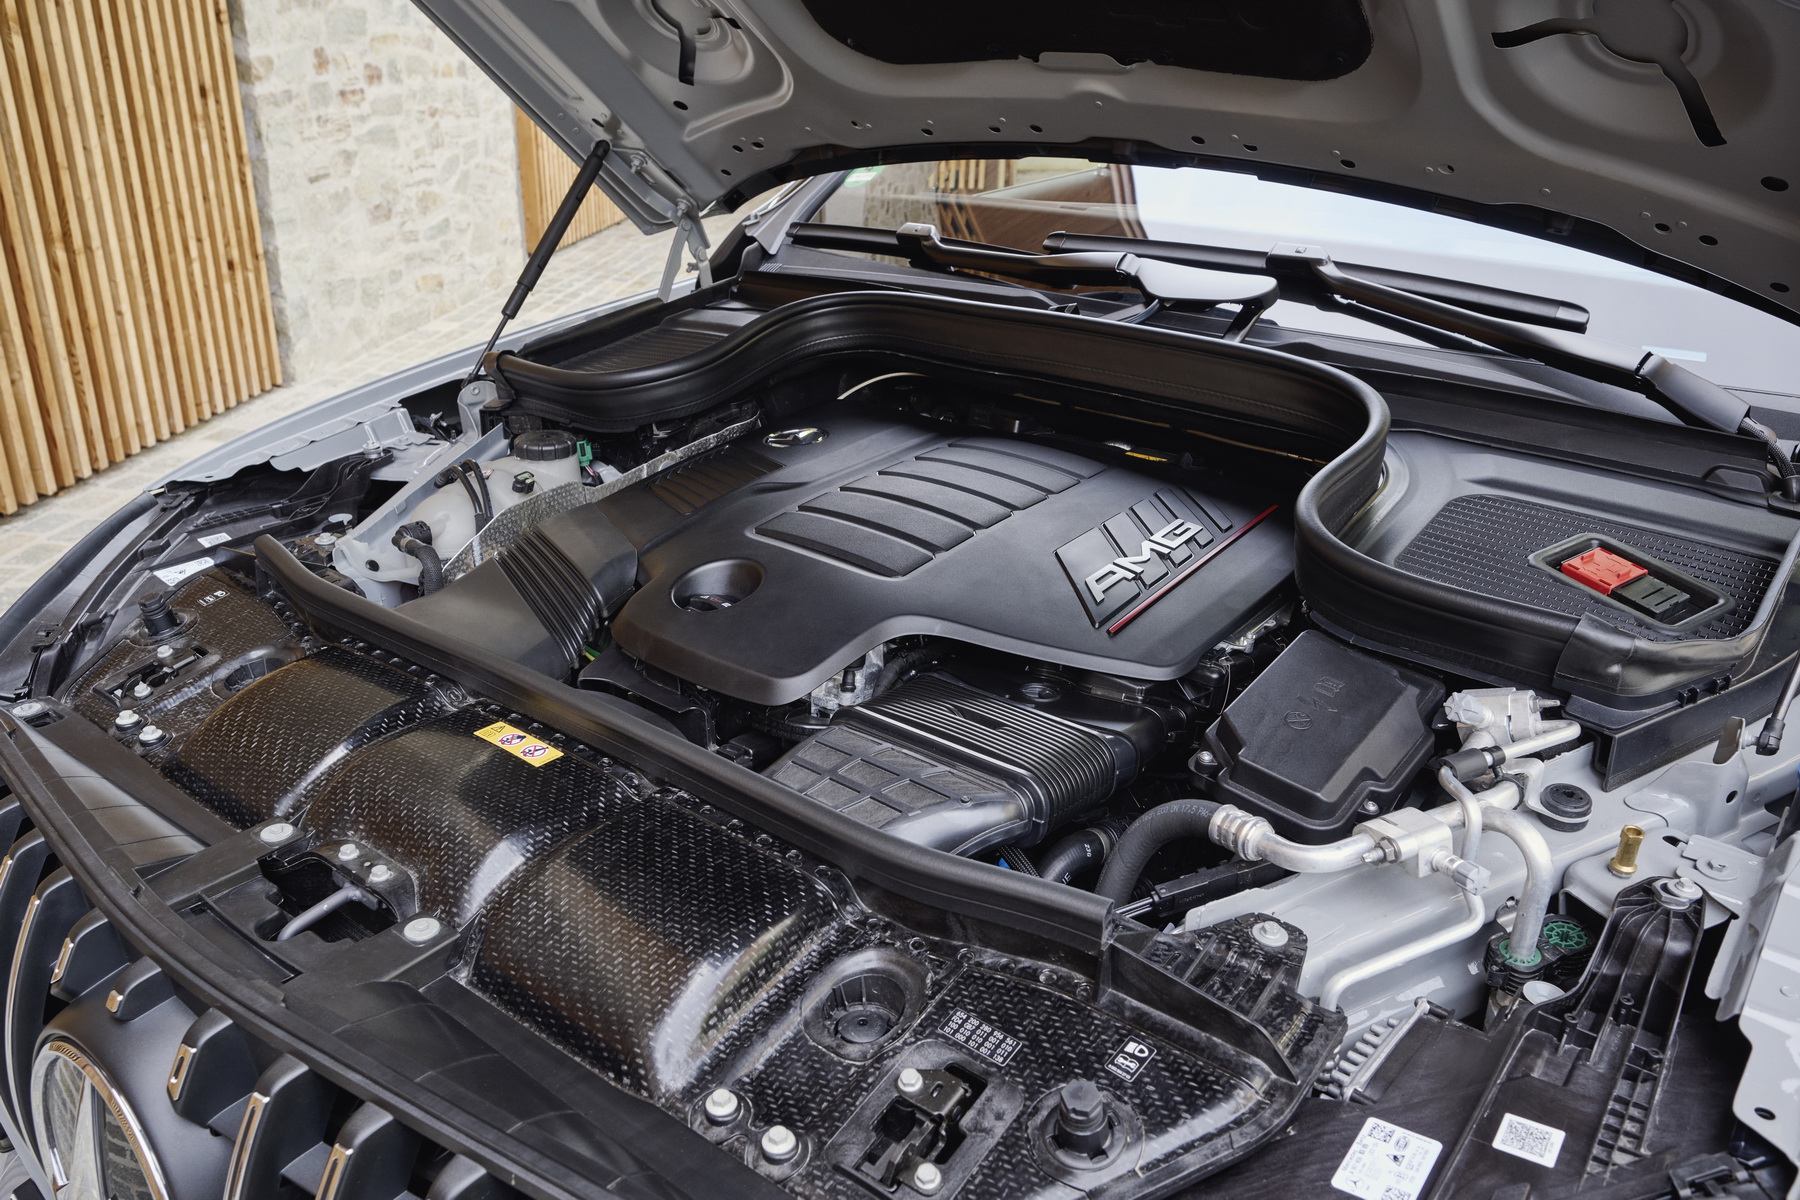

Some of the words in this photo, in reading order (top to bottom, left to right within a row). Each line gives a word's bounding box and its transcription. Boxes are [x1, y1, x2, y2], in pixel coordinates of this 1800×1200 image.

[1085, 518, 1204, 605] AMG
[1182, 805, 1197, 814] 17.5
[944, 1026, 953, 1034] 101
[955, 1033, 966, 1041] 000
[968, 1040, 978, 1048] 101
[980, 1047, 991, 1055] 001
[948, 1021, 958, 1029] 100
[959, 1028, 971, 1036] 010
[972, 1035, 983, 1043] 010
[984, 1041, 995, 1050] 001
[997, 1048, 1008, 1057] 011
[968, 1018, 979, 1026] 200
[1005, 1038, 1016, 1046] 561
[976, 1029, 987, 1038] 011
[988, 1036, 999, 1045] 001
[1001, 1043, 1012, 1051] 010
